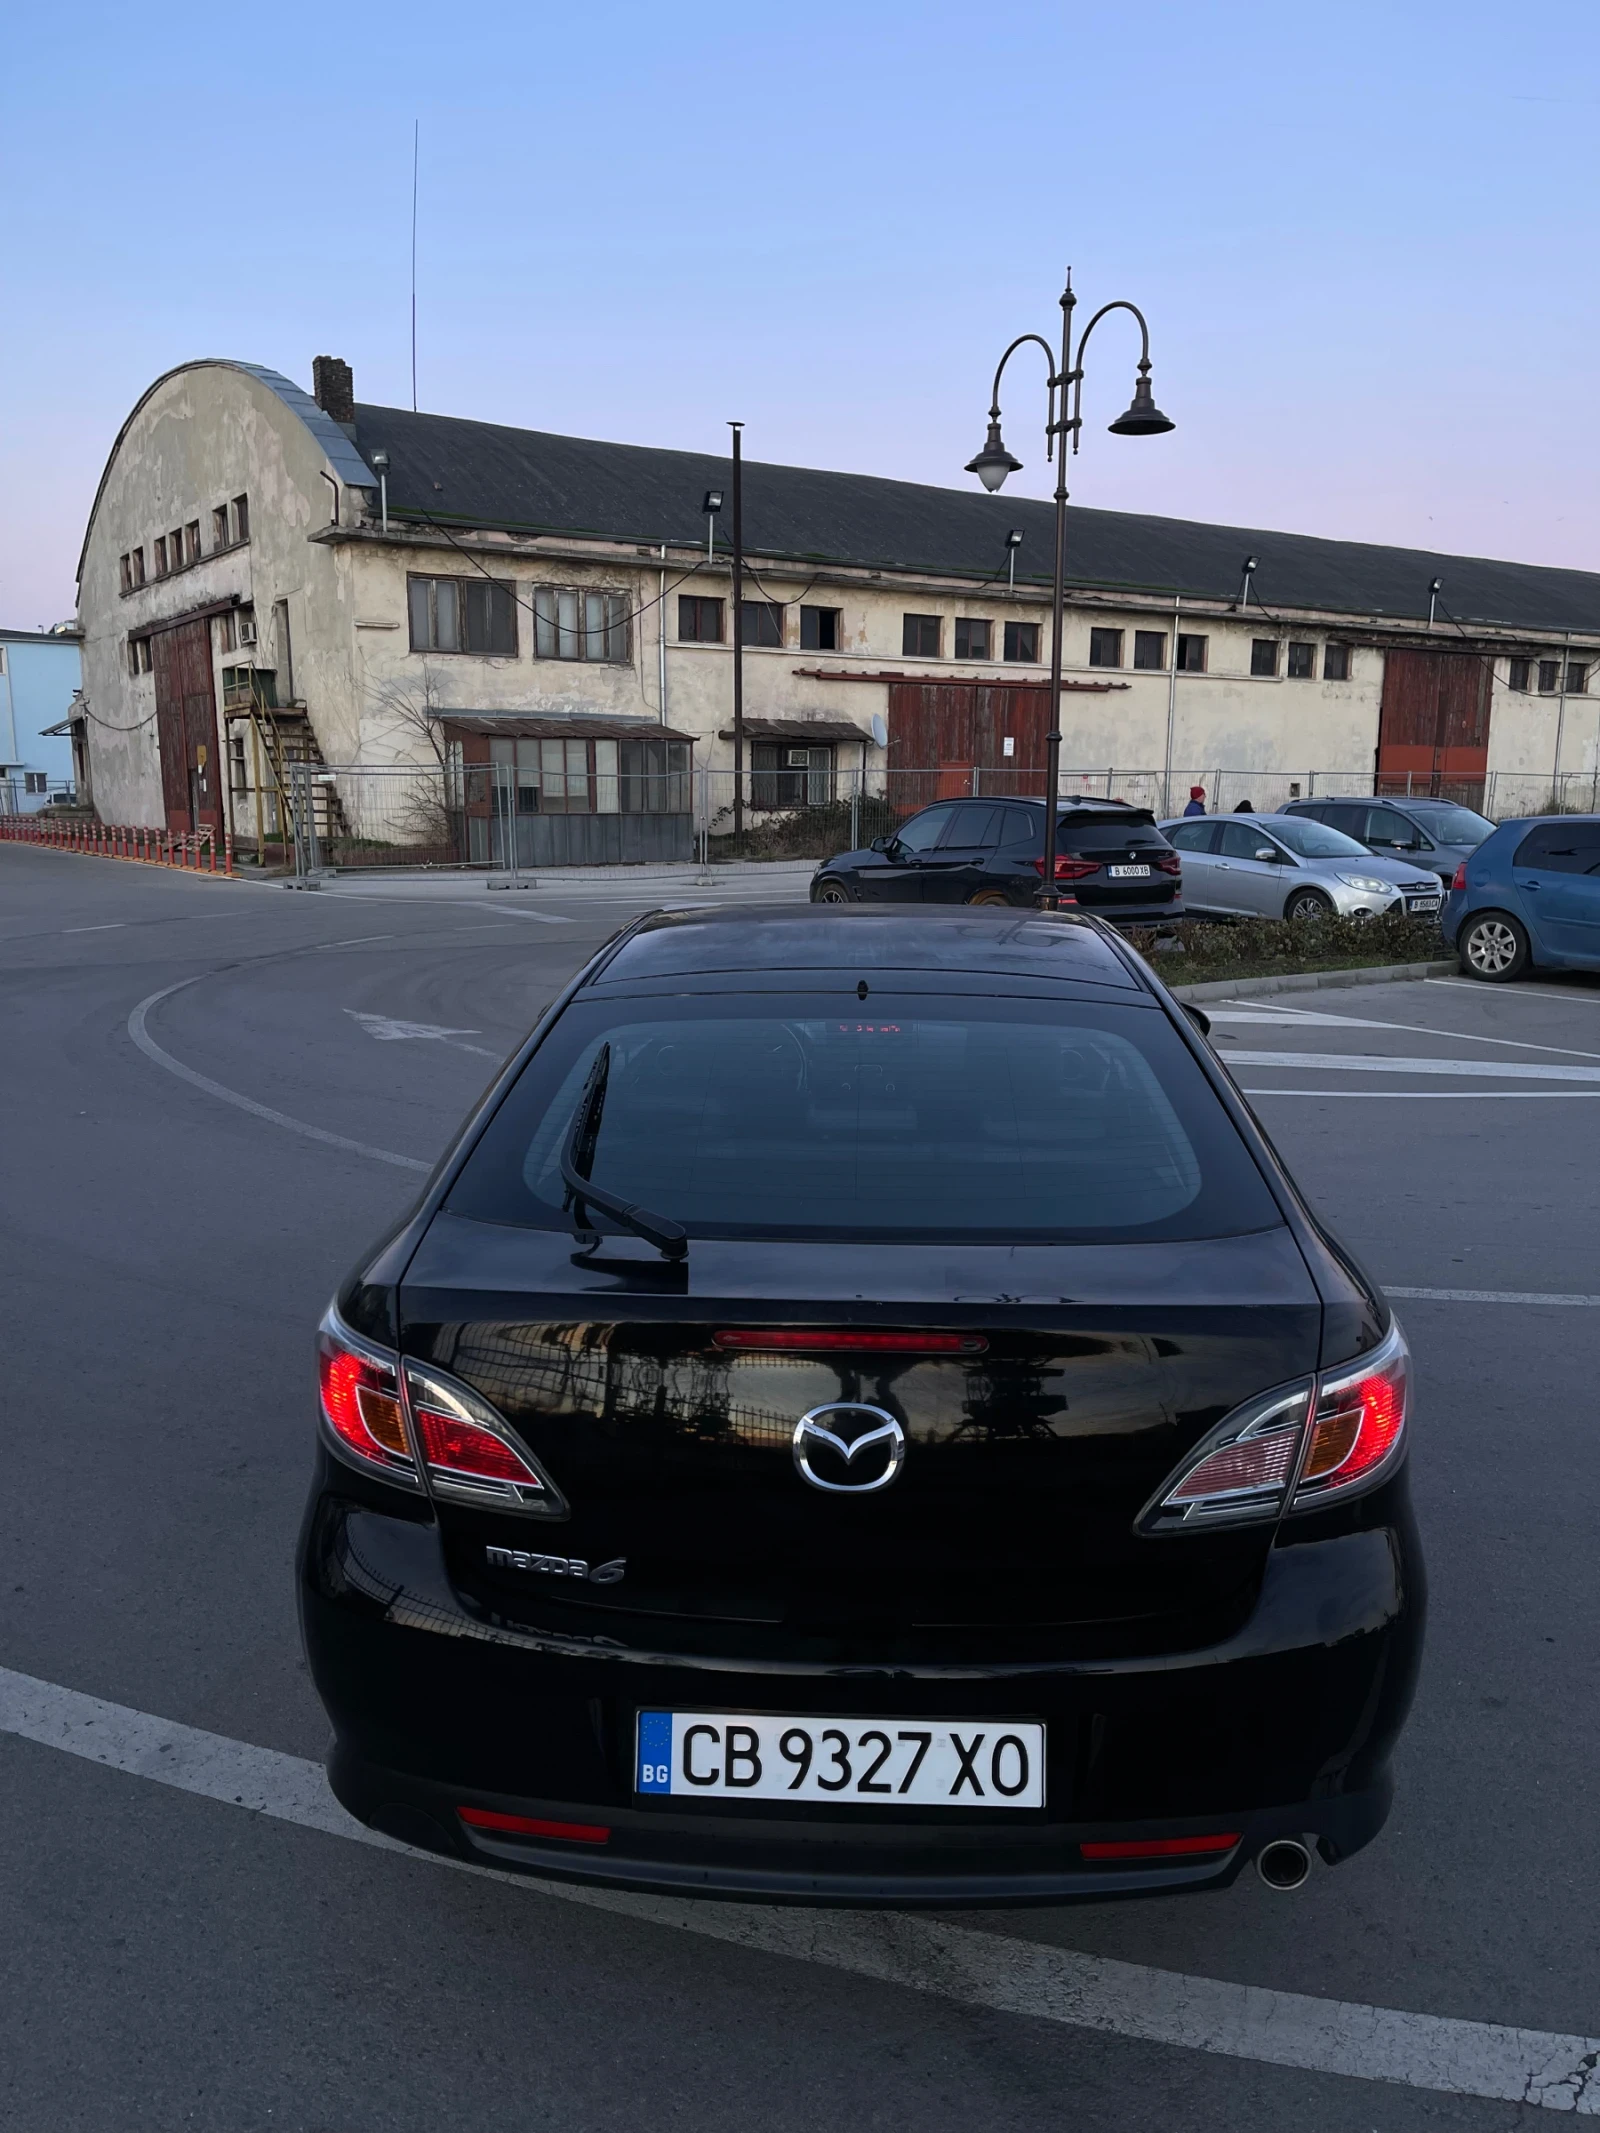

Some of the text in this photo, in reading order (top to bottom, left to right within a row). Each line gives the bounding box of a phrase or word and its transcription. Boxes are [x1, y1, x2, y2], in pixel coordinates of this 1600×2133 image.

[1115, 867, 1120, 876] B
[589, 1557, 627, 1584] 6
[642, 1724, 1030, 1797] BG CB 9327 XO
